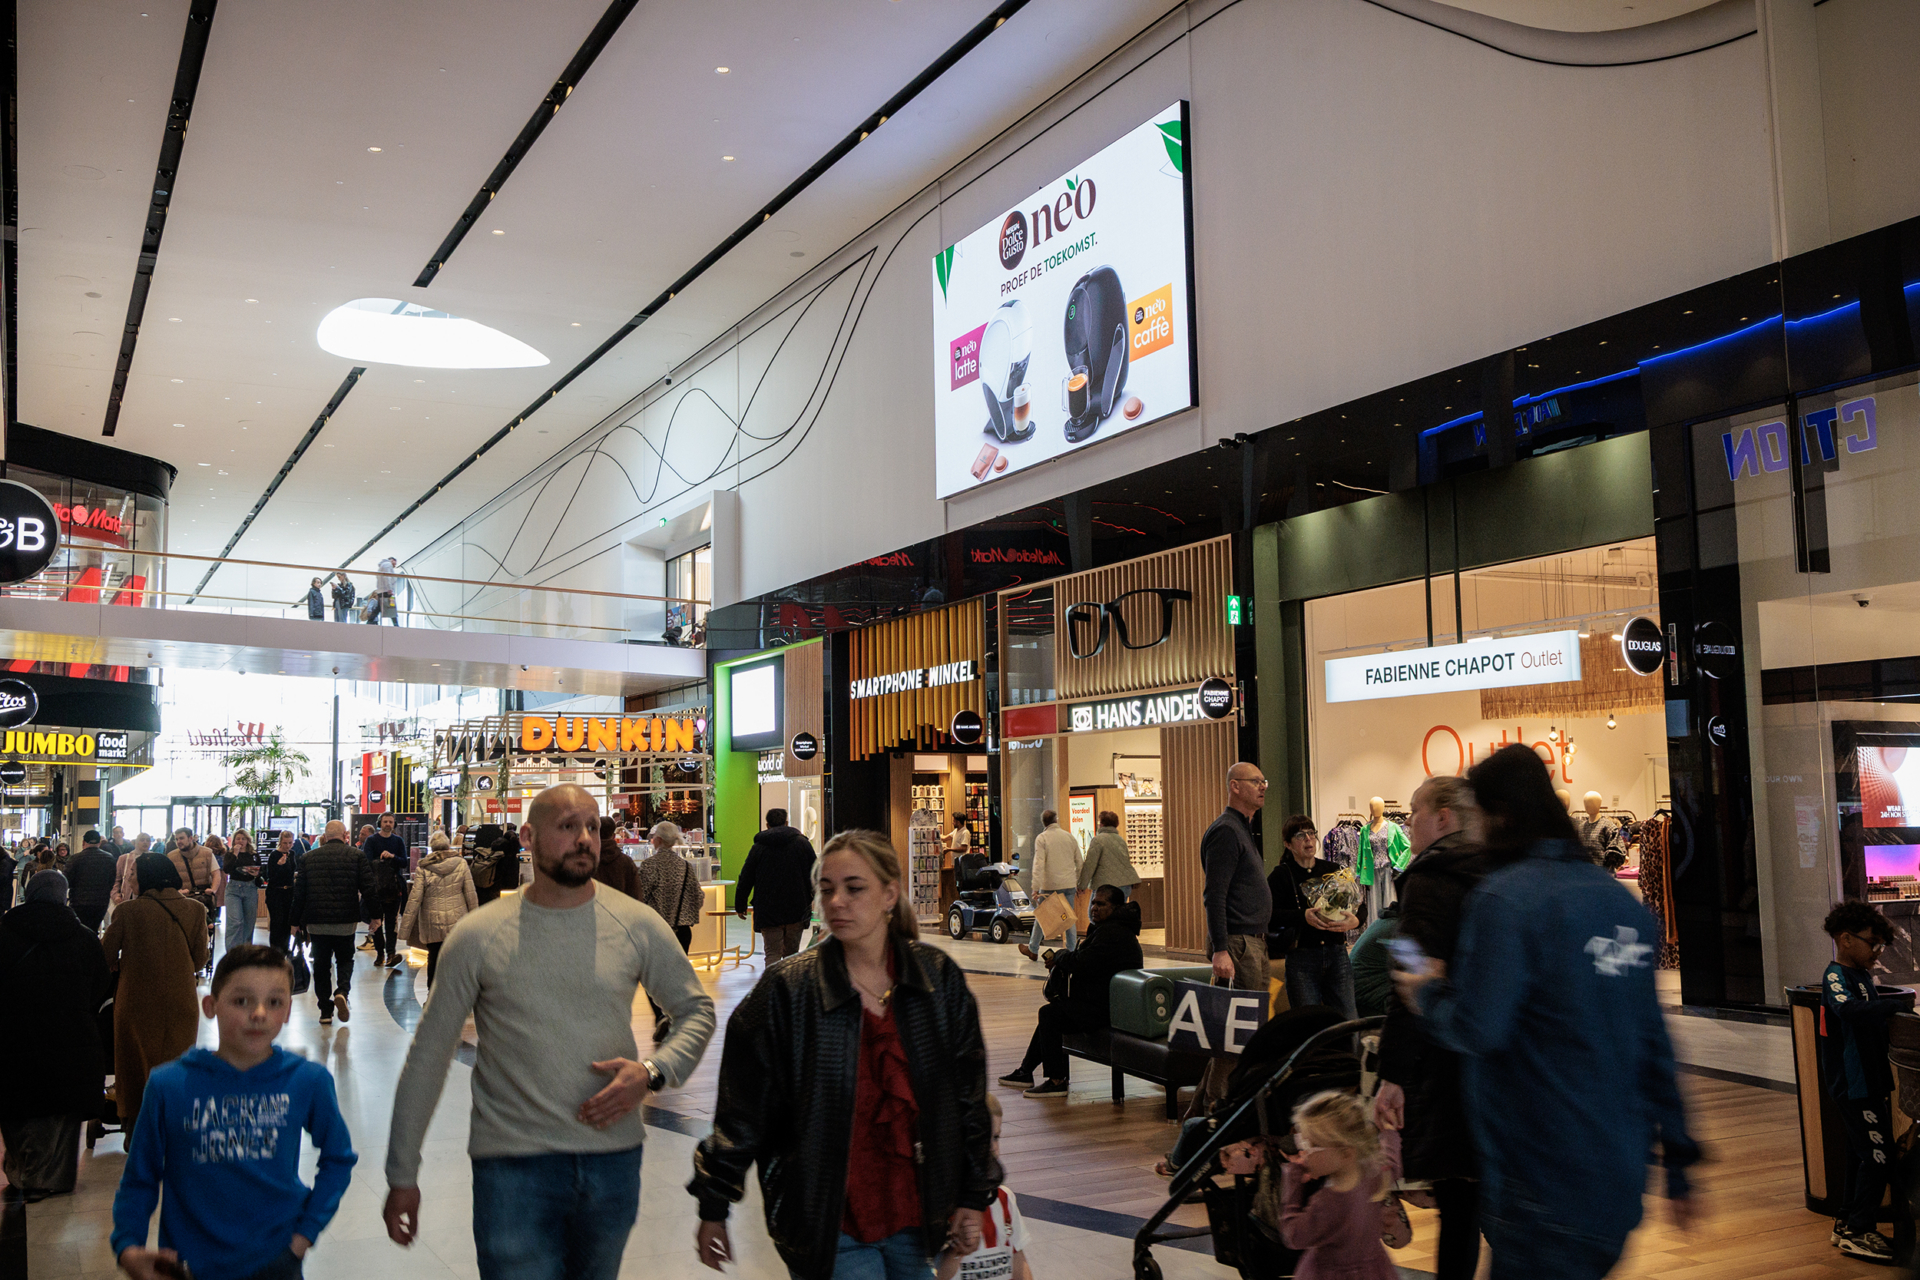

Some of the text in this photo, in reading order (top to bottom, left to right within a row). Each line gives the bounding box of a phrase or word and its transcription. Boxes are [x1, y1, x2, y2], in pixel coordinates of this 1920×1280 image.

[1001, 232, 1098, 297] PROEF DE TOEKOMST.
[1134, 316, 1170, 349] caffè
[955, 358, 977, 381] latte
[1628, 641, 1661, 652] DOUGLAS
[850, 660, 975, 700] SMARTPHONE WINKEL
[1366, 649, 1563, 685] FABIENNE CHAPOT Outlet
[1097, 700, 1141, 729] HANS
[2, 731, 95, 757] JUMBO
[98, 734, 127, 748] food
[98, 749, 126, 758] markt
[758, 753, 775, 772] world
